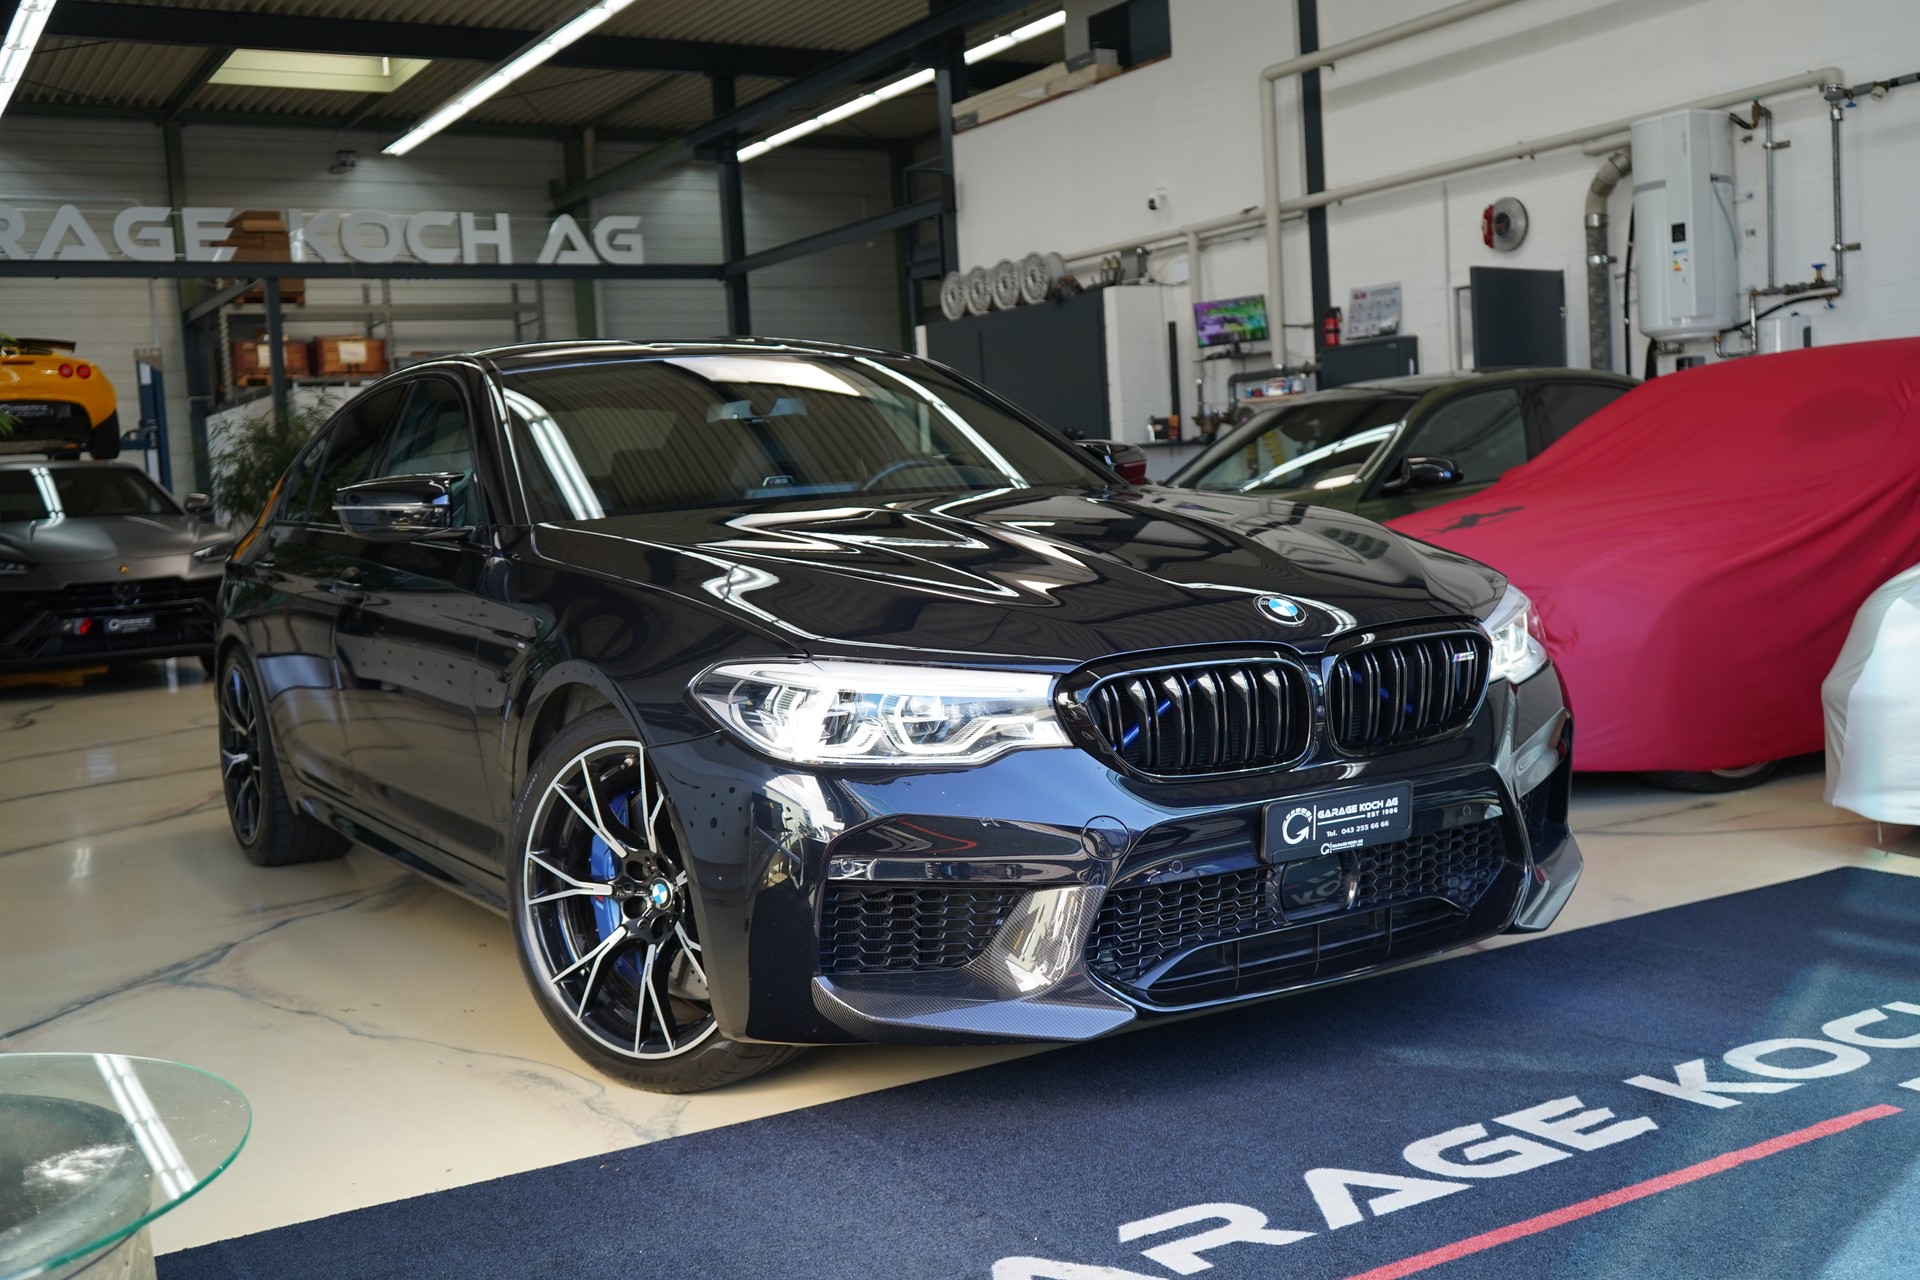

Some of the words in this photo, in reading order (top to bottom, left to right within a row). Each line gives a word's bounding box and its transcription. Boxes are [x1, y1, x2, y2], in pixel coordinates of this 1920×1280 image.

[288, 209, 512, 263] KOCH
[536, 213, 645, 264] AG
[1317, 804, 1358, 819] GARAGE
[1359, 799, 1384, 812] KOCH
[1385, 797, 1399, 808] AG
[1366, 810, 1380, 818] EST
[1326, 829, 1338, 838] Tel.
[1341, 826, 1355, 835] 043
[1356, 823, 1369, 832] 255
[1370, 821, 1379, 830] 66
[1380, 820, 1390, 828] 66
[1622, 1001, 1920, 1108] KOC
